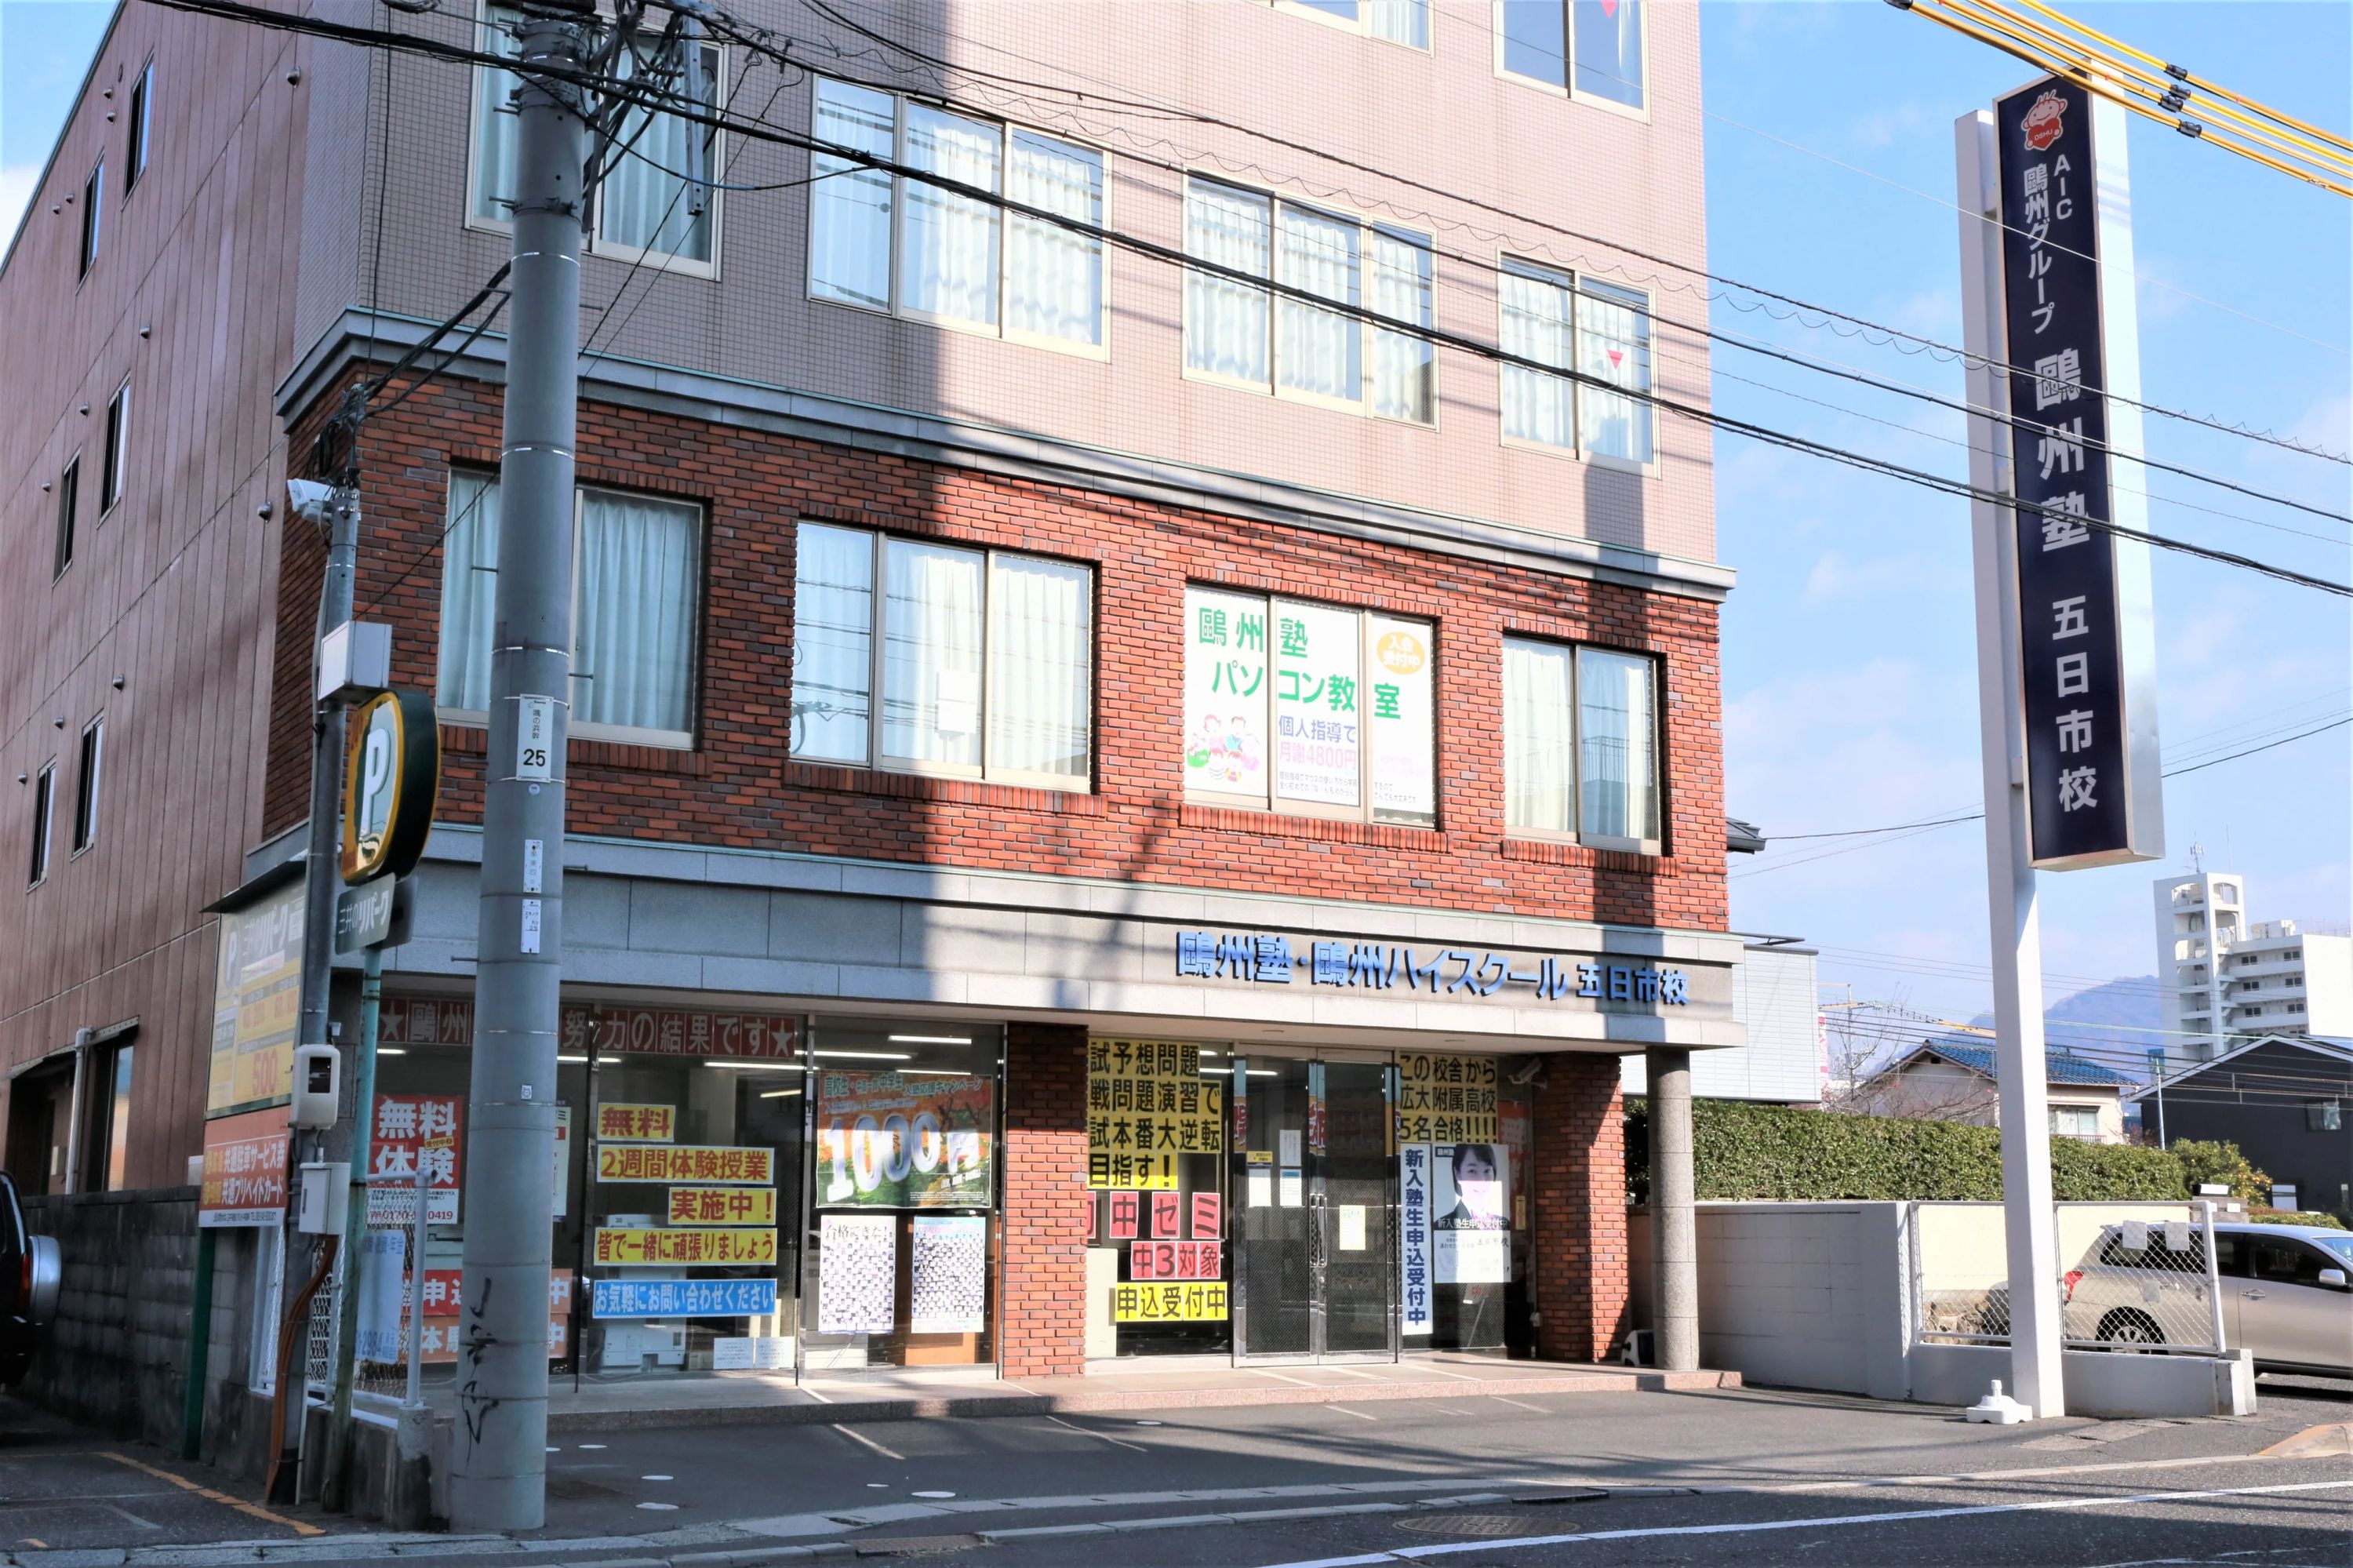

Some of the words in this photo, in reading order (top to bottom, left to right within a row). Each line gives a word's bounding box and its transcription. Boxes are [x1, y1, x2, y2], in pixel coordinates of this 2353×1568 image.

[2034, 129, 2053, 141] OSHU
[2053, 154, 2072, 220] AIC
[2052, 595, 2098, 813] 五日市校
[1278, 715, 1357, 744] 個人指導で
[523, 748, 546, 767] 25
[1279, 740, 1357, 771] 月謝4800円
[360, 727, 390, 840] P
[338, 890, 389, 936] 三井のリパーク
[1574, 962, 1690, 1006] 五日市校
[252, 1048, 278, 1097] 500
[1090, 1042, 1199, 1077] 試予想問題
[1400, 1055, 1496, 1084] この校舎から
[1089, 1079, 1220, 1115] 戦問題演習で
[1400, 1084, 1497, 1113] 広大附属高校
[378, 1098, 456, 1140] 無料
[601, 1107, 670, 1137] 無料
[1089, 1116, 1220, 1151] 試本番大逆転
[375, 1144, 456, 1185] 体験
[601, 1149, 768, 1181] 2週間体験授業
[598, 1231, 773, 1261] 皆で一緒に頑張りましょう
[1405, 1148, 1426, 1326] 新入塾生申込受付中
[1133, 1244, 1219, 1277] 中3対象
[595, 1282, 775, 1313] お気軽にお問い合わせください
[1117, 1286, 1226, 1319] 申込受付中
